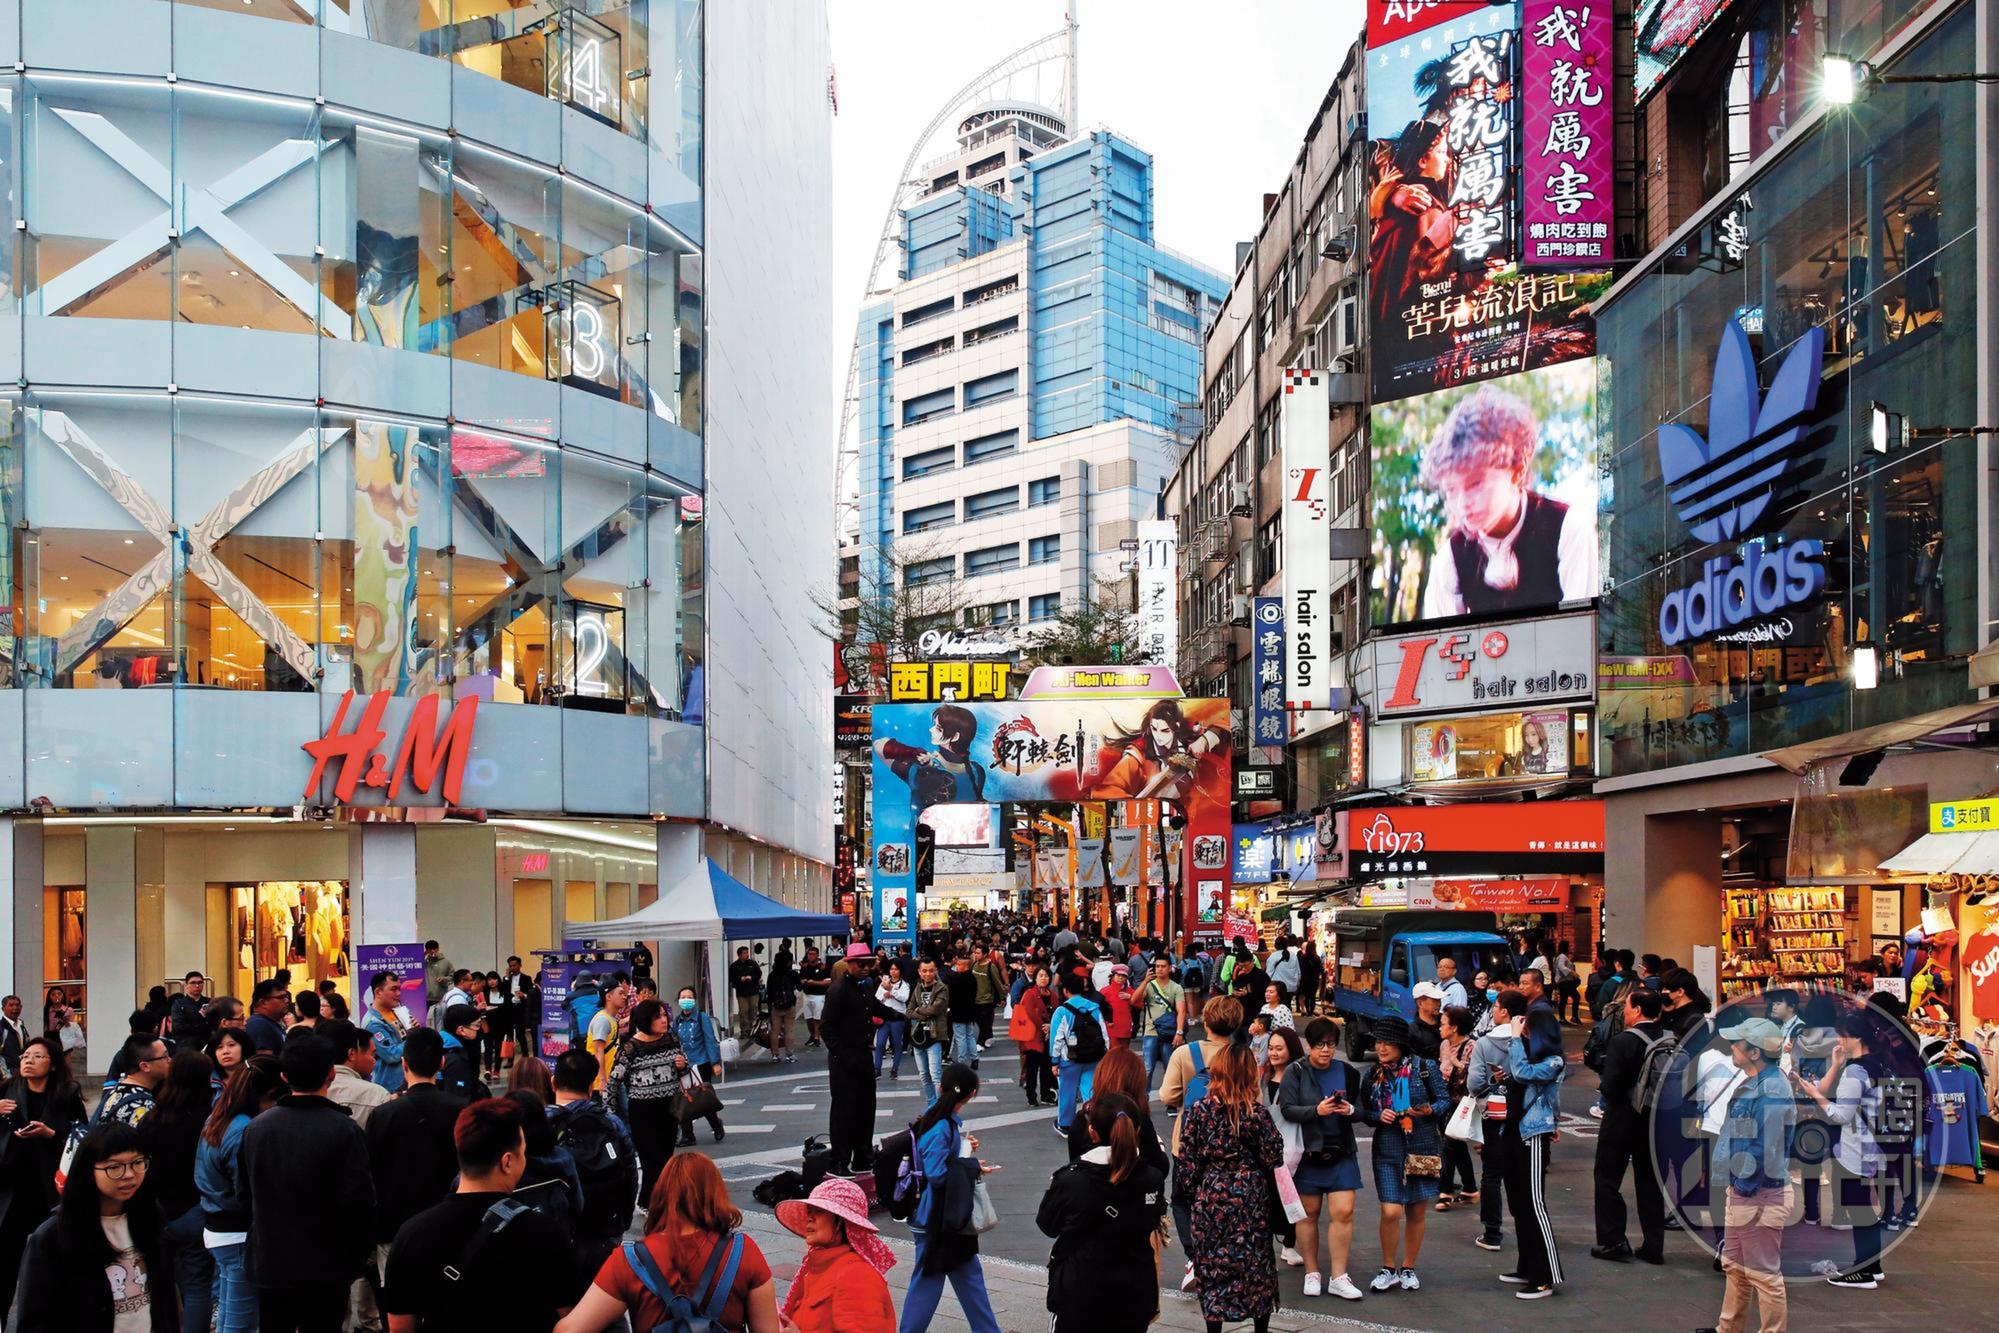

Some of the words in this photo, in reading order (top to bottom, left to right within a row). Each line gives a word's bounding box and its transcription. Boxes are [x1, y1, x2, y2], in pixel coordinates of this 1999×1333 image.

[572, 39, 607, 113] 4
[1529, 222, 1607, 240] 燒肉吃到飽
[1402, 273, 1577, 341] 苦兒流浪記
[566, 300, 605, 380] 3
[1297, 590, 1317, 627] hair
[1660, 540, 1824, 645] adidas
[571, 616, 610, 694] 2
[1297, 632, 1317, 688] salon
[890, 662, 1012, 700] 西門町
[1258, 631, 1284, 741] 雪龍眼鏡
[1473, 676, 1517, 700] hair
[1525, 670, 1587, 695] salon
[302, 689, 479, 806] H&M
[1957, 806, 1991, 824] 支付寶
[1413, 898, 1432, 906] CNN
[1468, 884, 1518, 897] Taiwan
[1518, 881, 1558, 898] No.1
[115, 1292, 151, 1314] aspe
